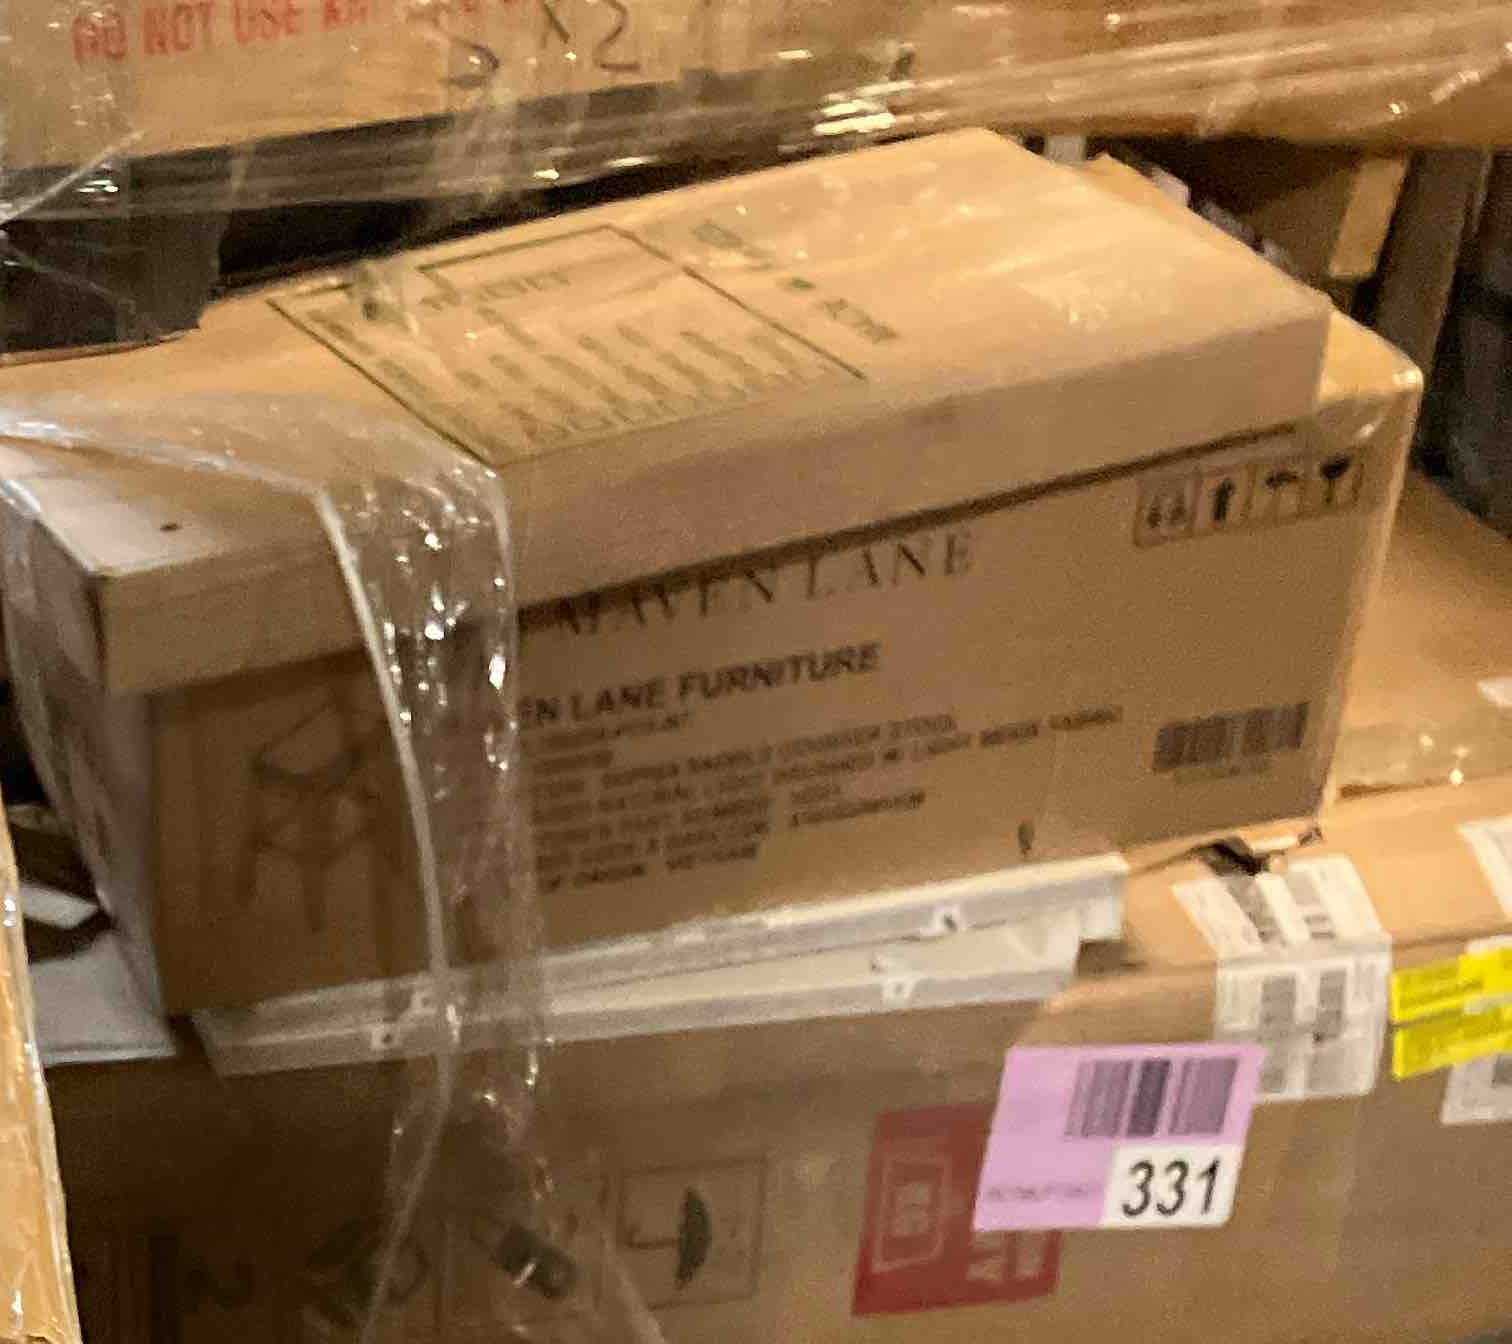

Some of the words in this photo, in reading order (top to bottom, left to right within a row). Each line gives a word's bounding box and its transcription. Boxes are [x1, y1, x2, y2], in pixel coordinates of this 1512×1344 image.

[143, 1, 215, 55] NOT
[233, 0, 299, 44] USE
[570, 676, 664, 719] LANE
[677, 641, 882, 704] FURNITURE
[1121, 1156, 1221, 1218] 331
